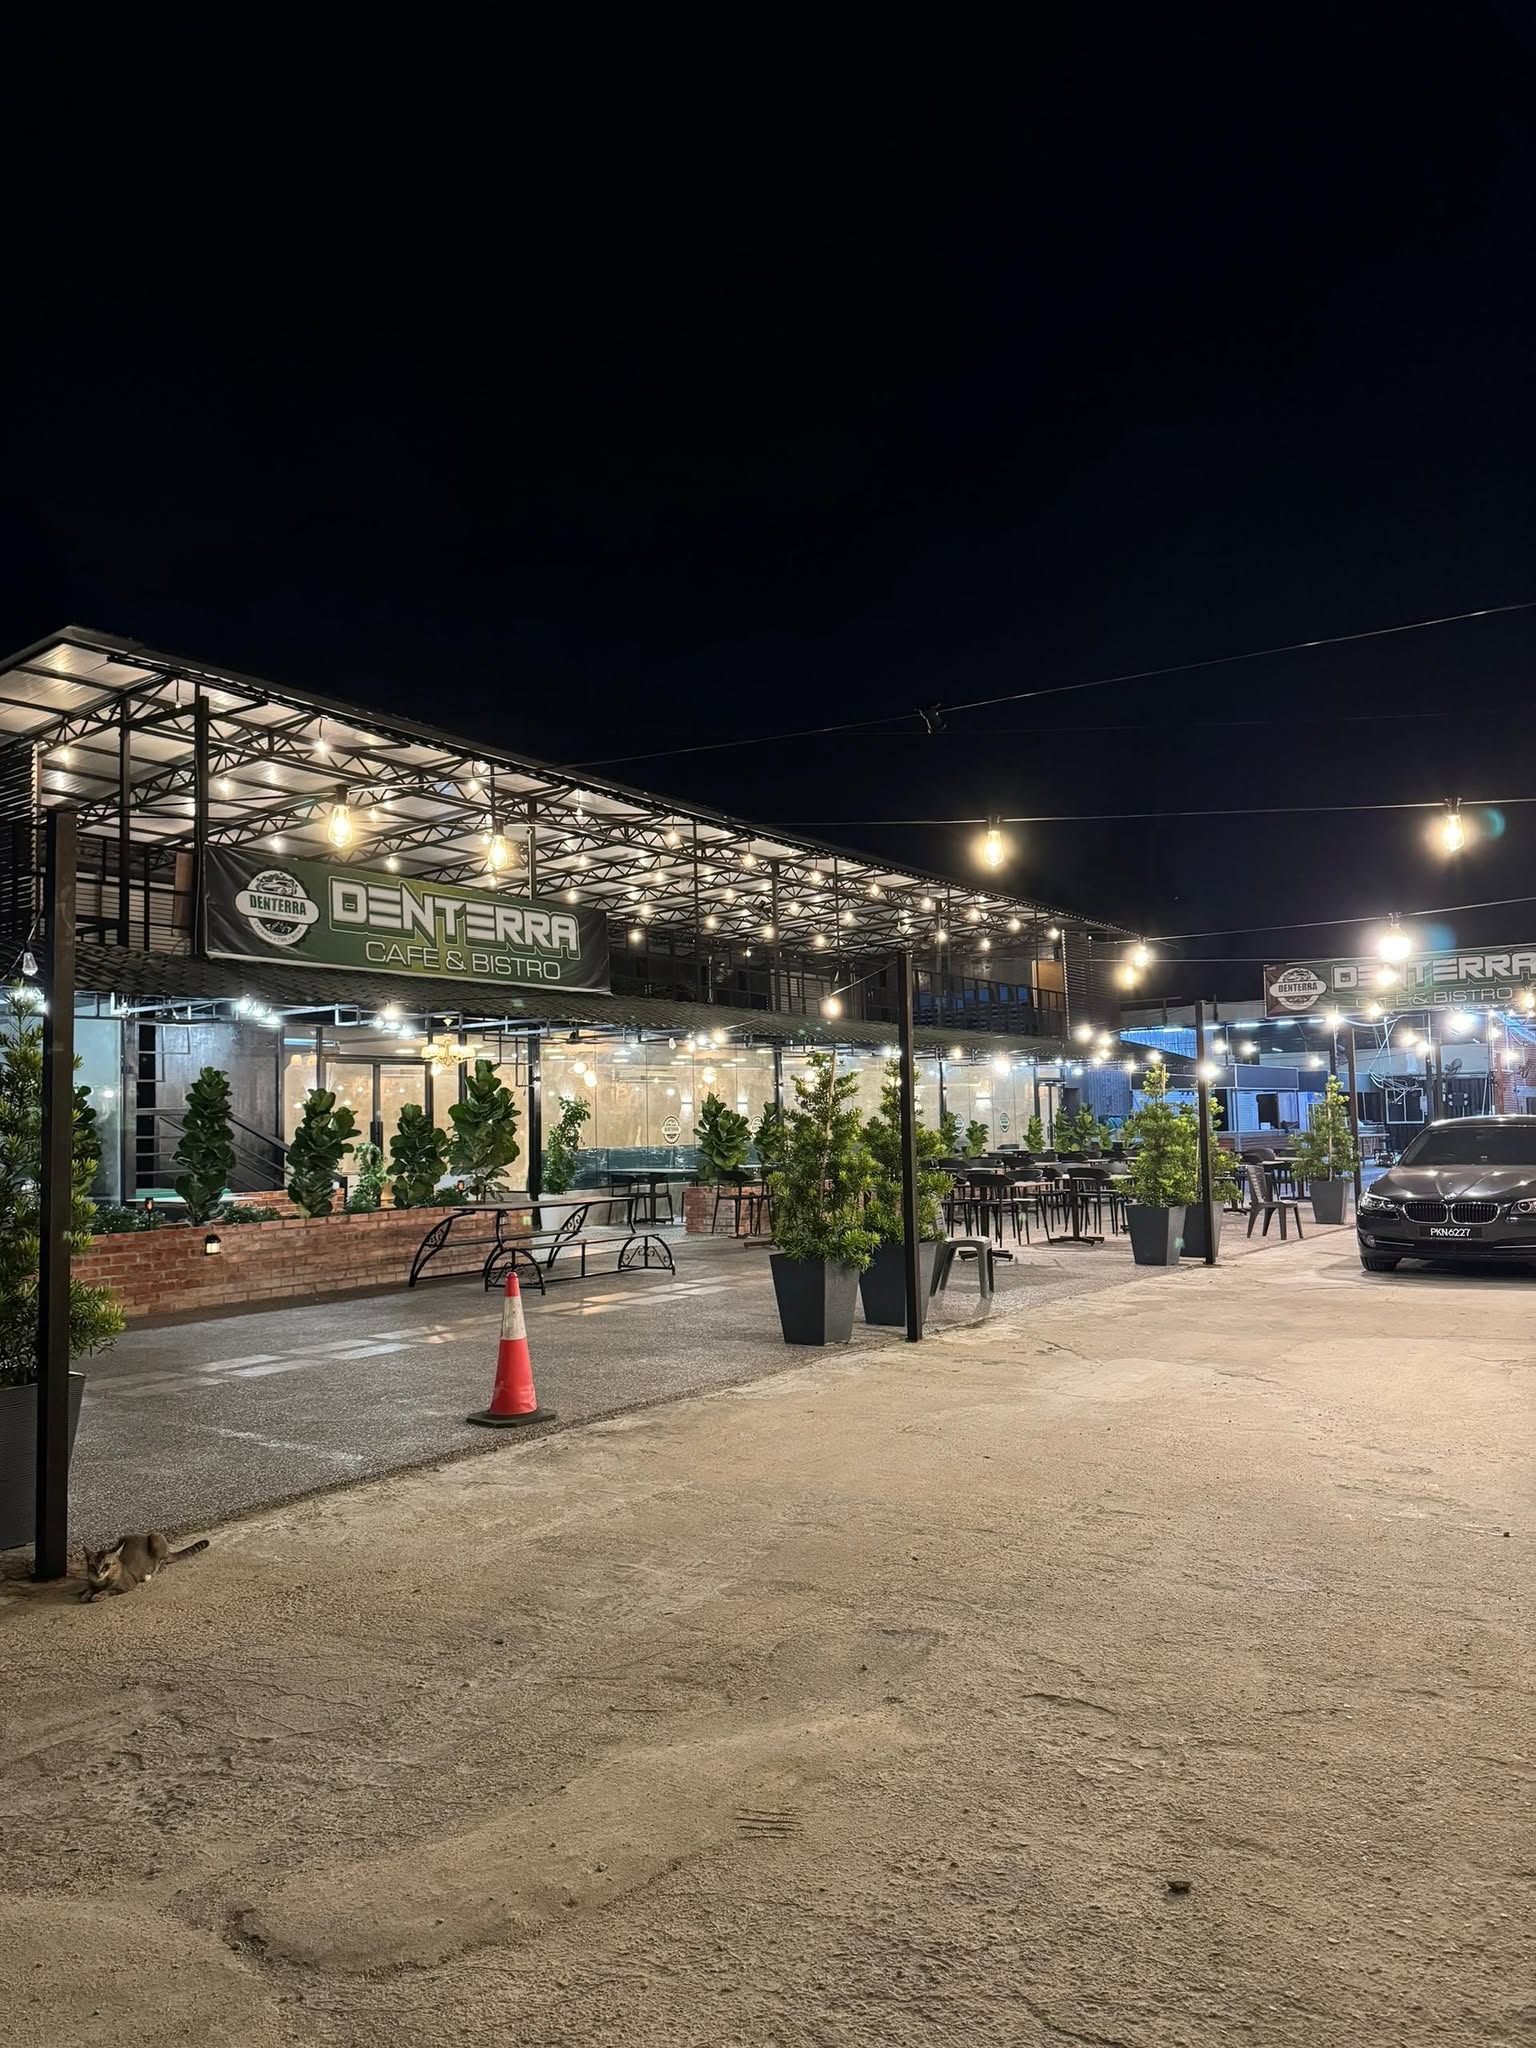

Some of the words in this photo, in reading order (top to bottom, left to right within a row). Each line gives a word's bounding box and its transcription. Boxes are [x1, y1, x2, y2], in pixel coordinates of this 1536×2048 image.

[248, 894, 307, 916] DENTERRA
[331, 878, 579, 953] DENTERRA
[365, 941, 440, 968] CAFE
[445, 950, 467, 971] &
[472, 953, 561, 980] BISTRO
[1277, 982, 1318, 993] DENTERRA
[1412, 993, 1429, 1005] &
[1433, 987, 1513, 1004] BISTRO
[1429, 1227, 1471, 1237] PKN6227
